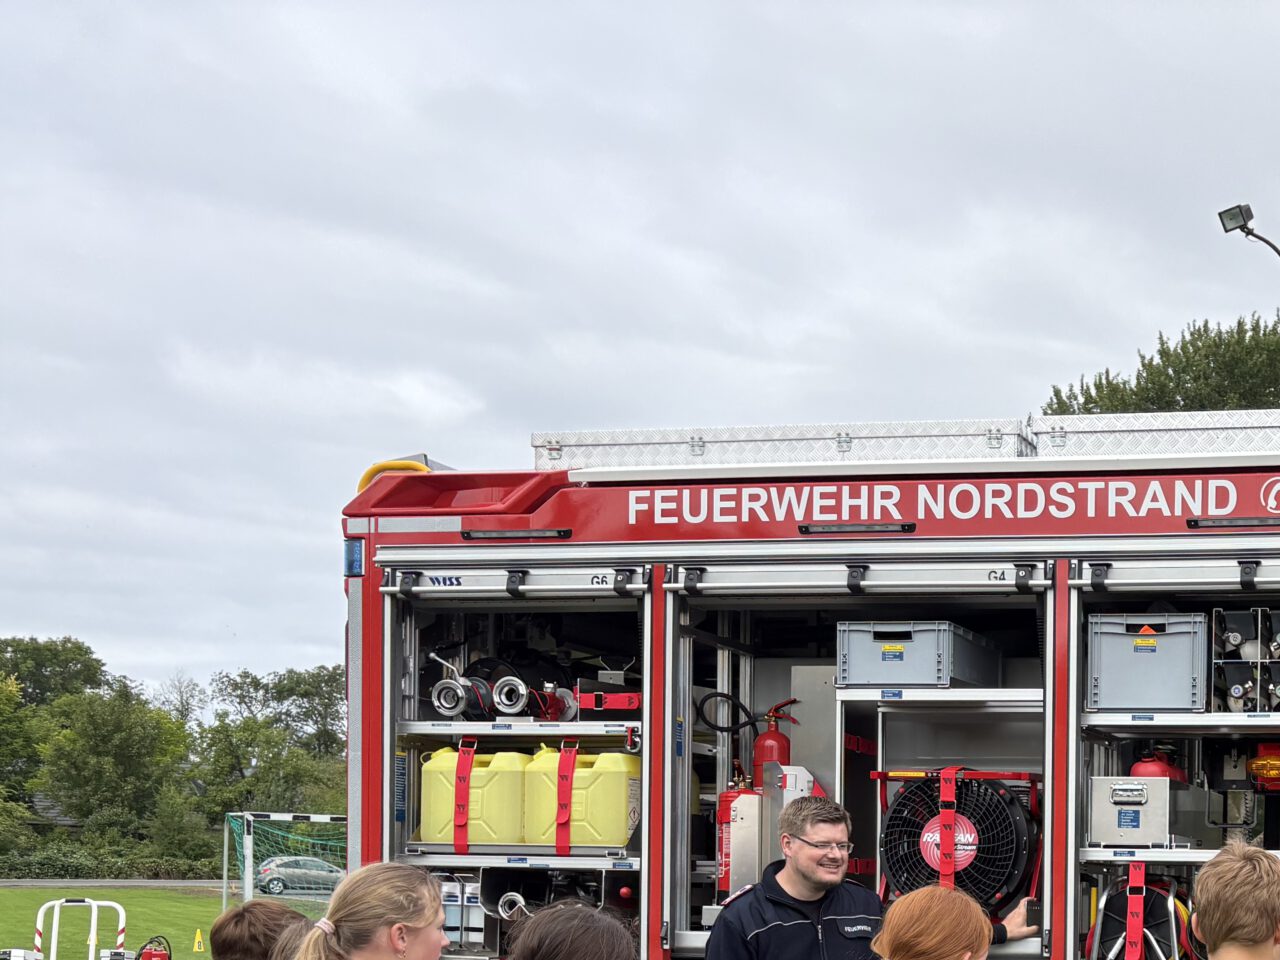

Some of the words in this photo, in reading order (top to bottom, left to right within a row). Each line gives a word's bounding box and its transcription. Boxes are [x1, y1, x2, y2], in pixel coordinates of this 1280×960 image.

[628, 485, 902, 525] FEUERWEHR
[917, 479, 1237, 520] NORDSTRAND
[591, 575, 608, 586] G6
